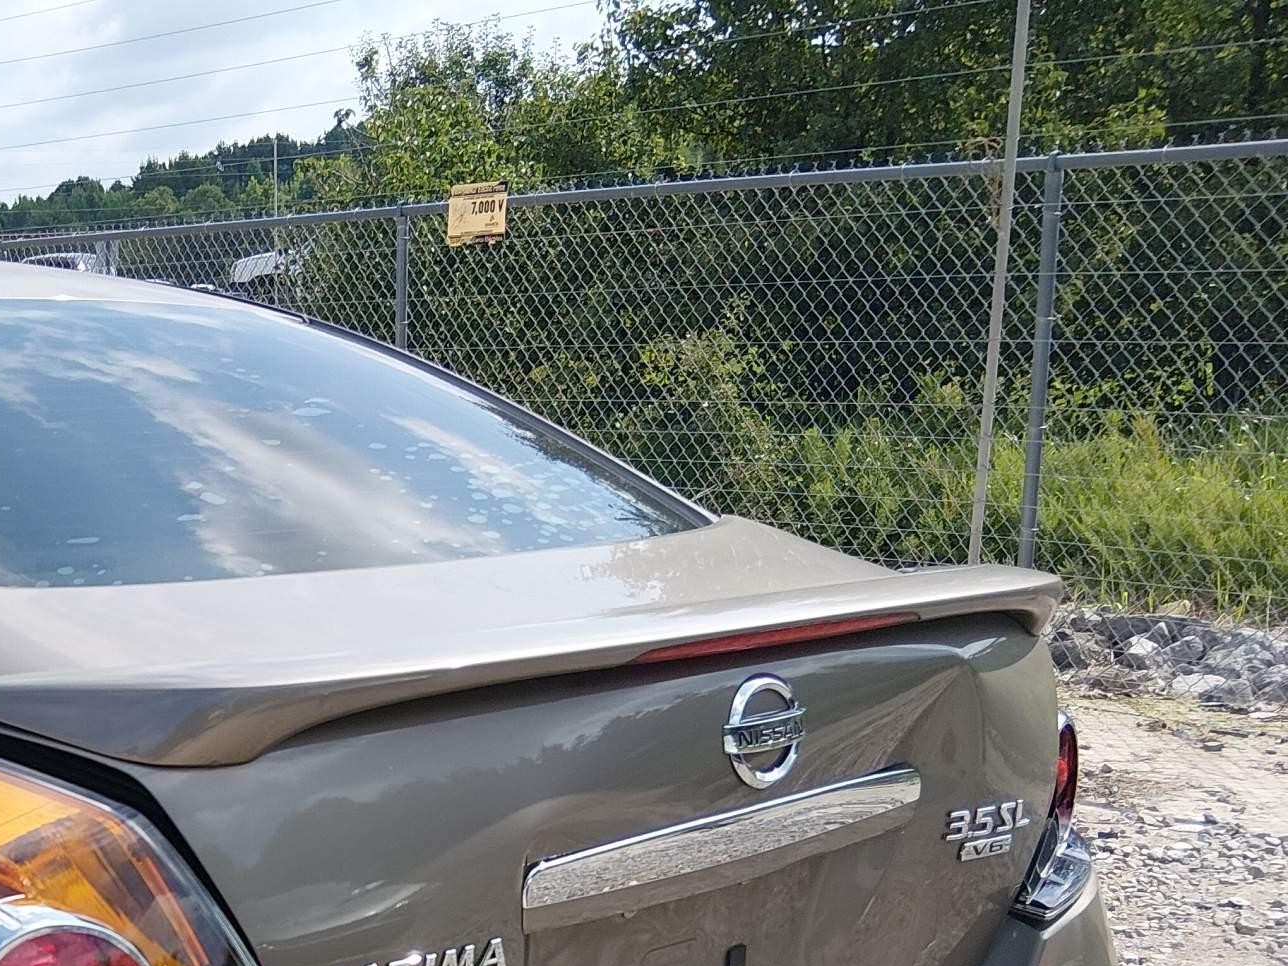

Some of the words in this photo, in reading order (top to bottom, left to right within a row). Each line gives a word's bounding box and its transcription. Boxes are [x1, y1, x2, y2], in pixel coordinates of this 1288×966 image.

[471, 200, 495, 216] 7,000
[498, 199, 504, 213] V
[737, 718, 805, 747] NISSAN
[973, 841, 1004, 856] V6
